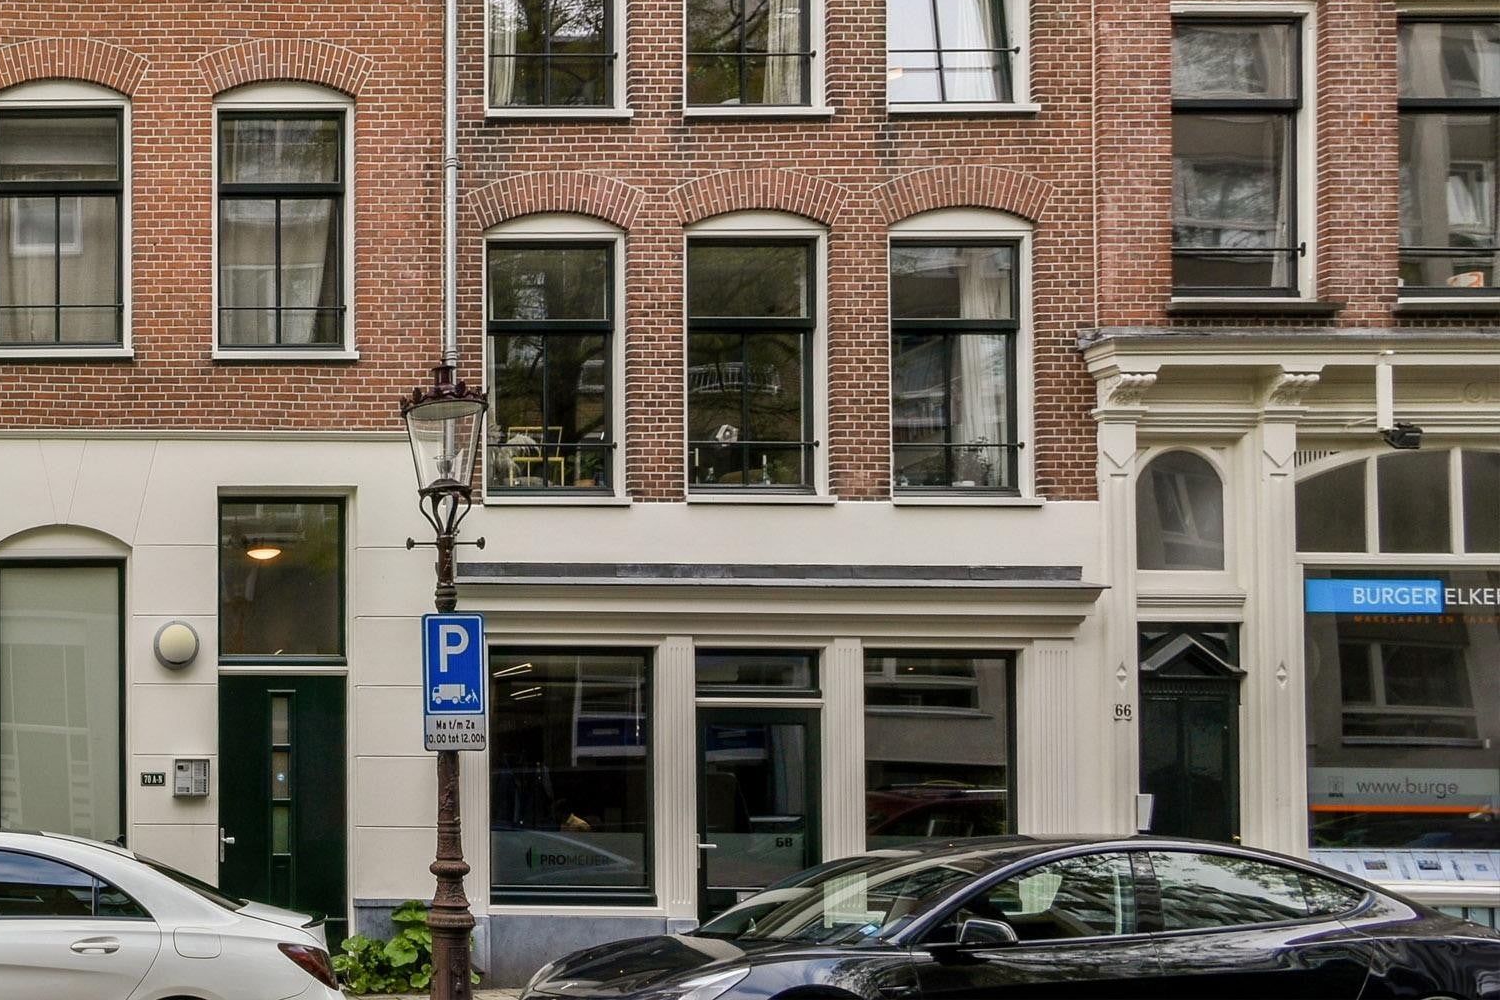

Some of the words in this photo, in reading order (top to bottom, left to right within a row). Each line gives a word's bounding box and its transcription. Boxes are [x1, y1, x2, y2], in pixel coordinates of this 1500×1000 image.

[1352, 587, 1438, 605] BURGER
[439, 624, 470, 673] P
[1115, 703, 1132, 717] 66
[436, 720, 447, 730] Ma
[449, 719, 464, 730] t/m
[466, 719, 475, 729] Za
[448, 734, 460, 744] tot
[461, 733, 485, 743] 12.00h
[144, 775, 152, 784] 70
[1356, 776, 1459, 799] www.burge
